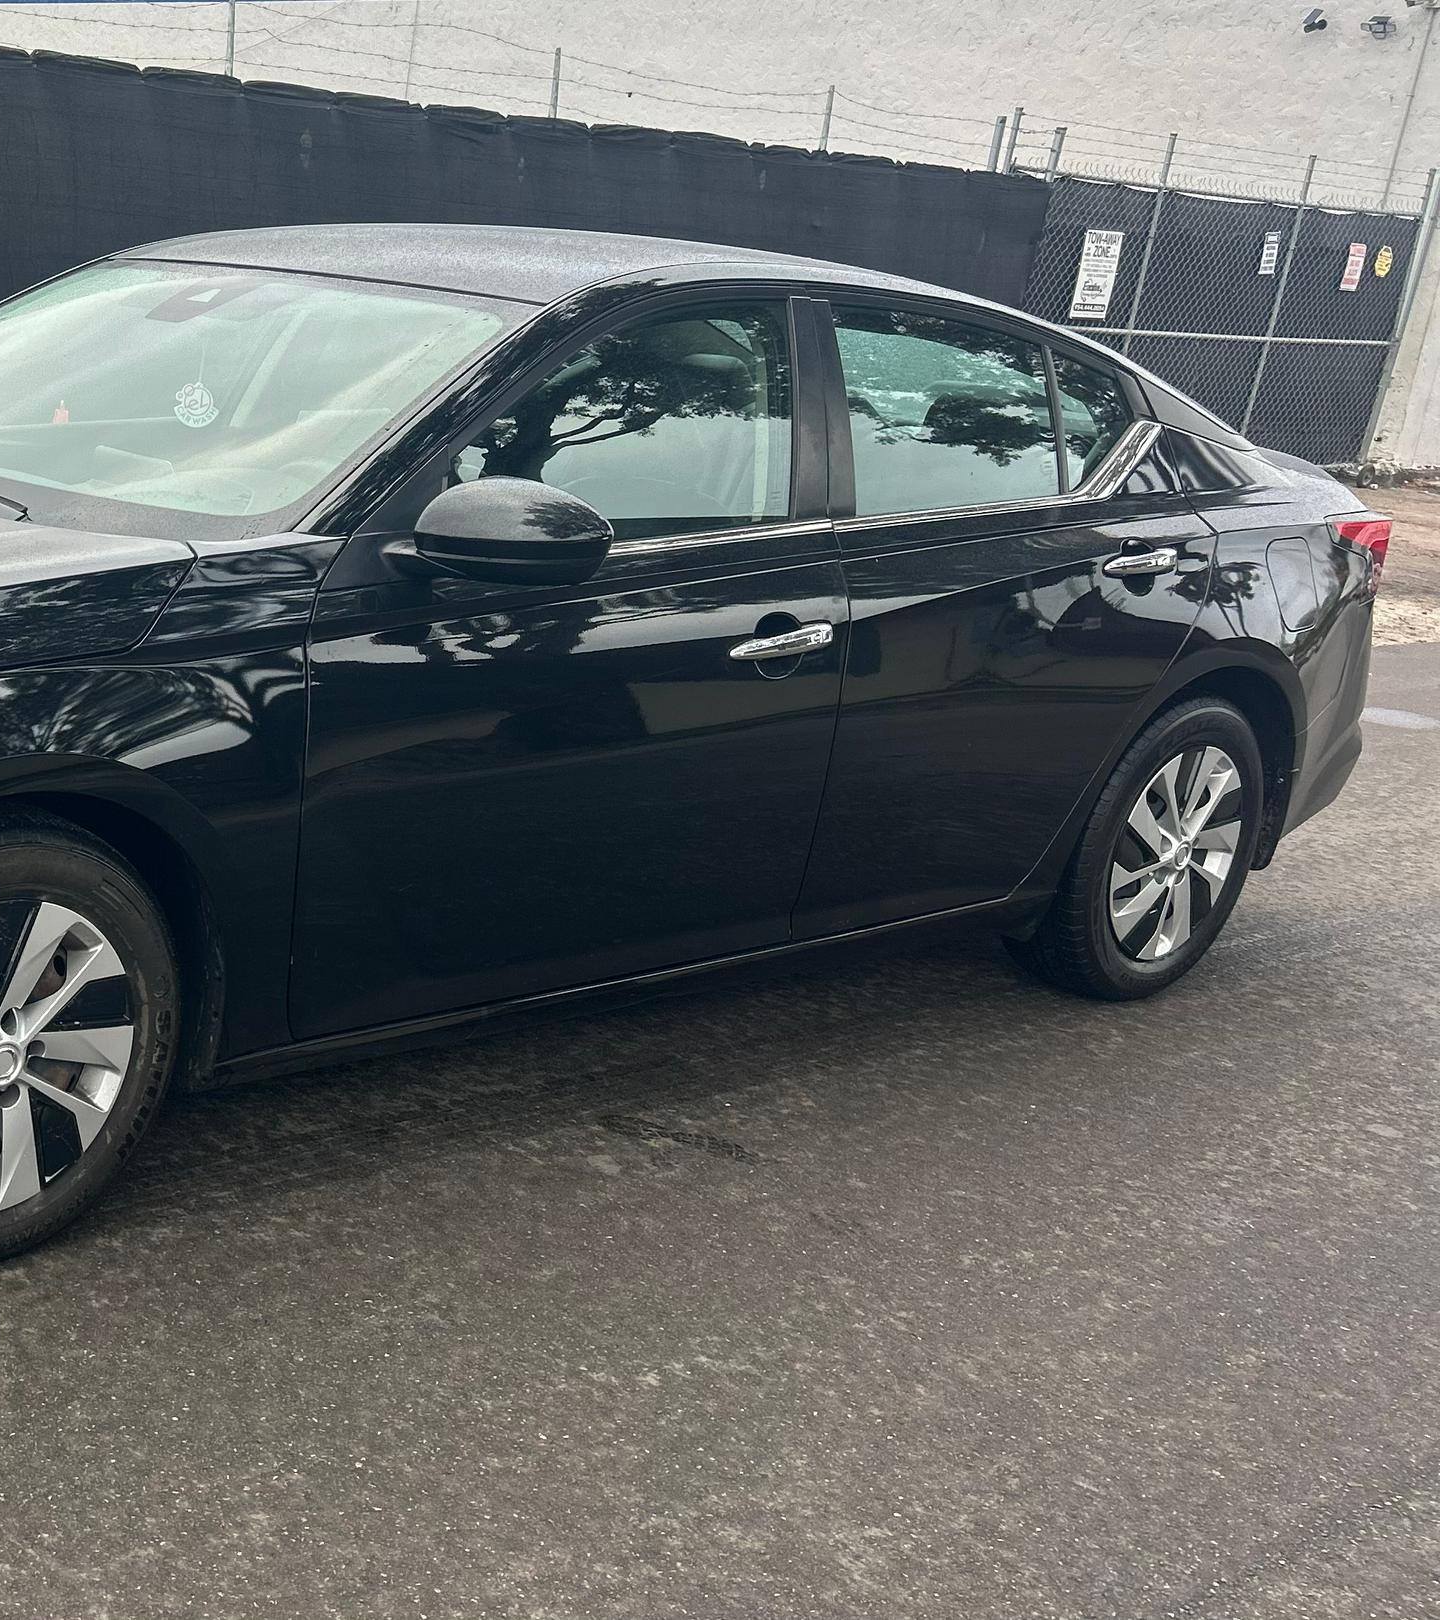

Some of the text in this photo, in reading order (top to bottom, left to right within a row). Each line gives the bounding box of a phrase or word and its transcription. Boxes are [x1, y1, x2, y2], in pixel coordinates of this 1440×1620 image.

[1087, 231, 1120, 245] TOW-AWAY
[1093, 245, 1111, 258] ZONE
[176, 406, 217, 424] CAR WASH
